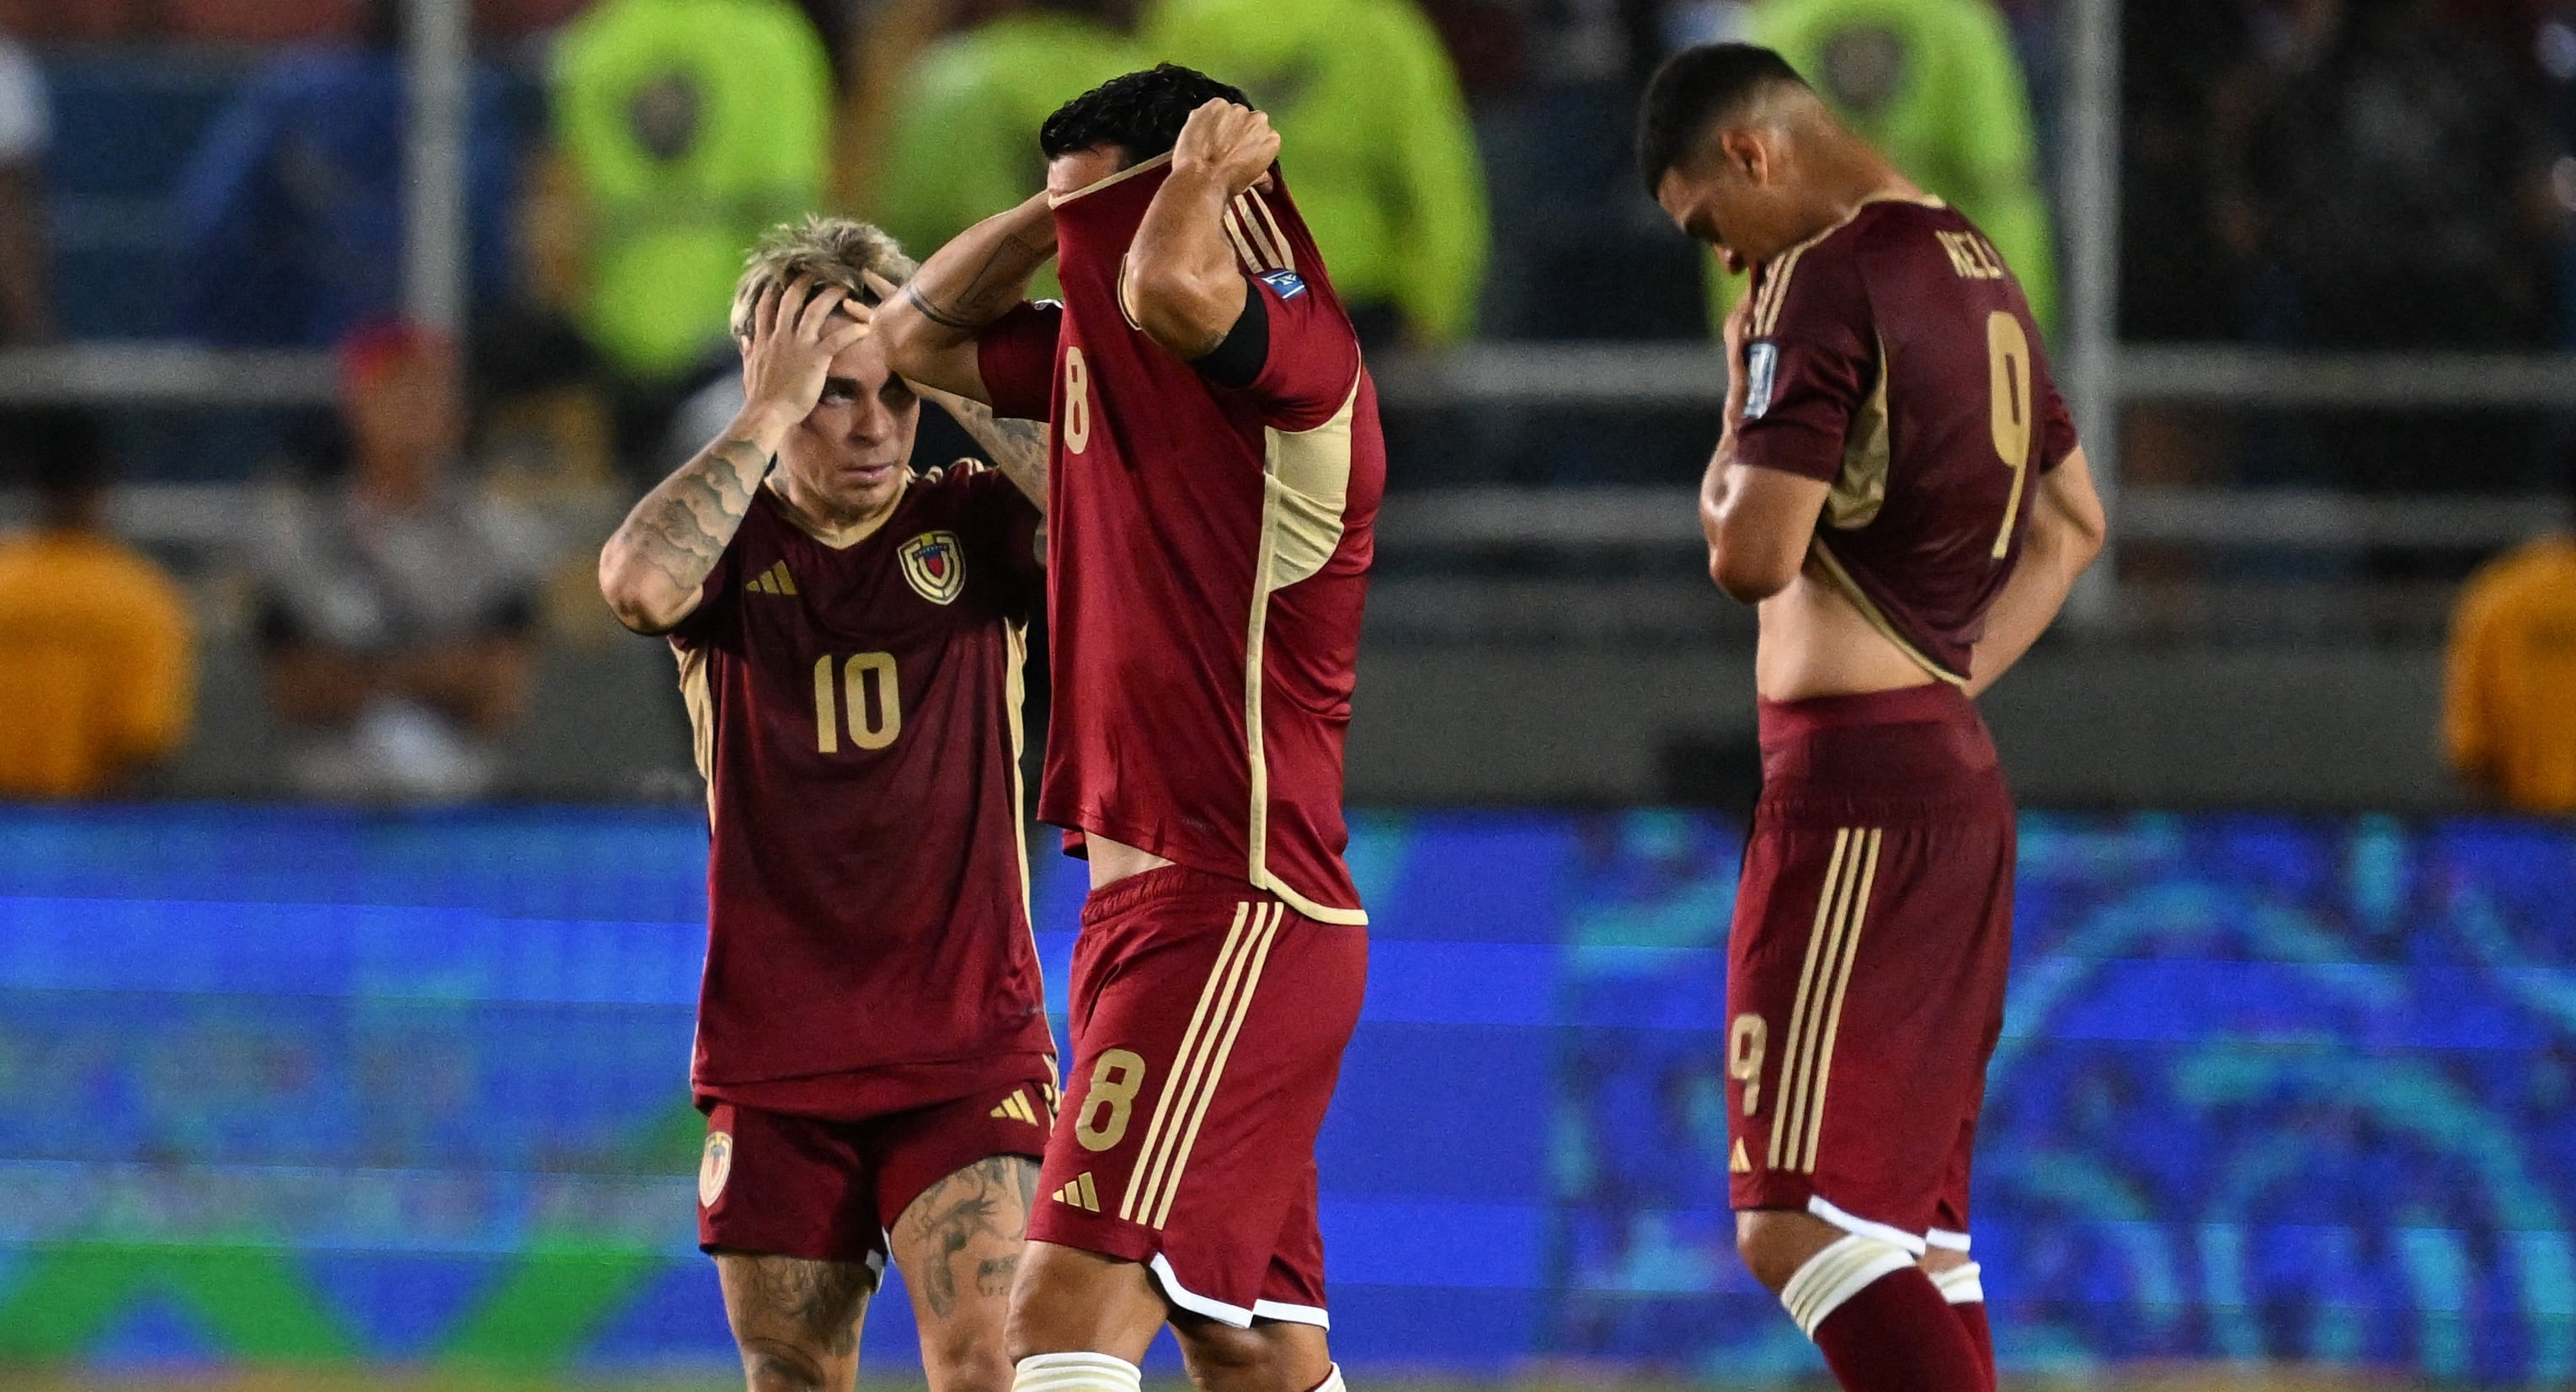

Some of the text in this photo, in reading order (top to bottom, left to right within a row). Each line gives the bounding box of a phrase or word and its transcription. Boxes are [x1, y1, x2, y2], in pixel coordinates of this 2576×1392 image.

[1064, 346, 1090, 455] 8
[1987, 311, 2031, 559] 9
[814, 651, 901, 754] 10
[1075, 1048, 1146, 1152] 8
[1730, 1013, 1768, 1117] 9
